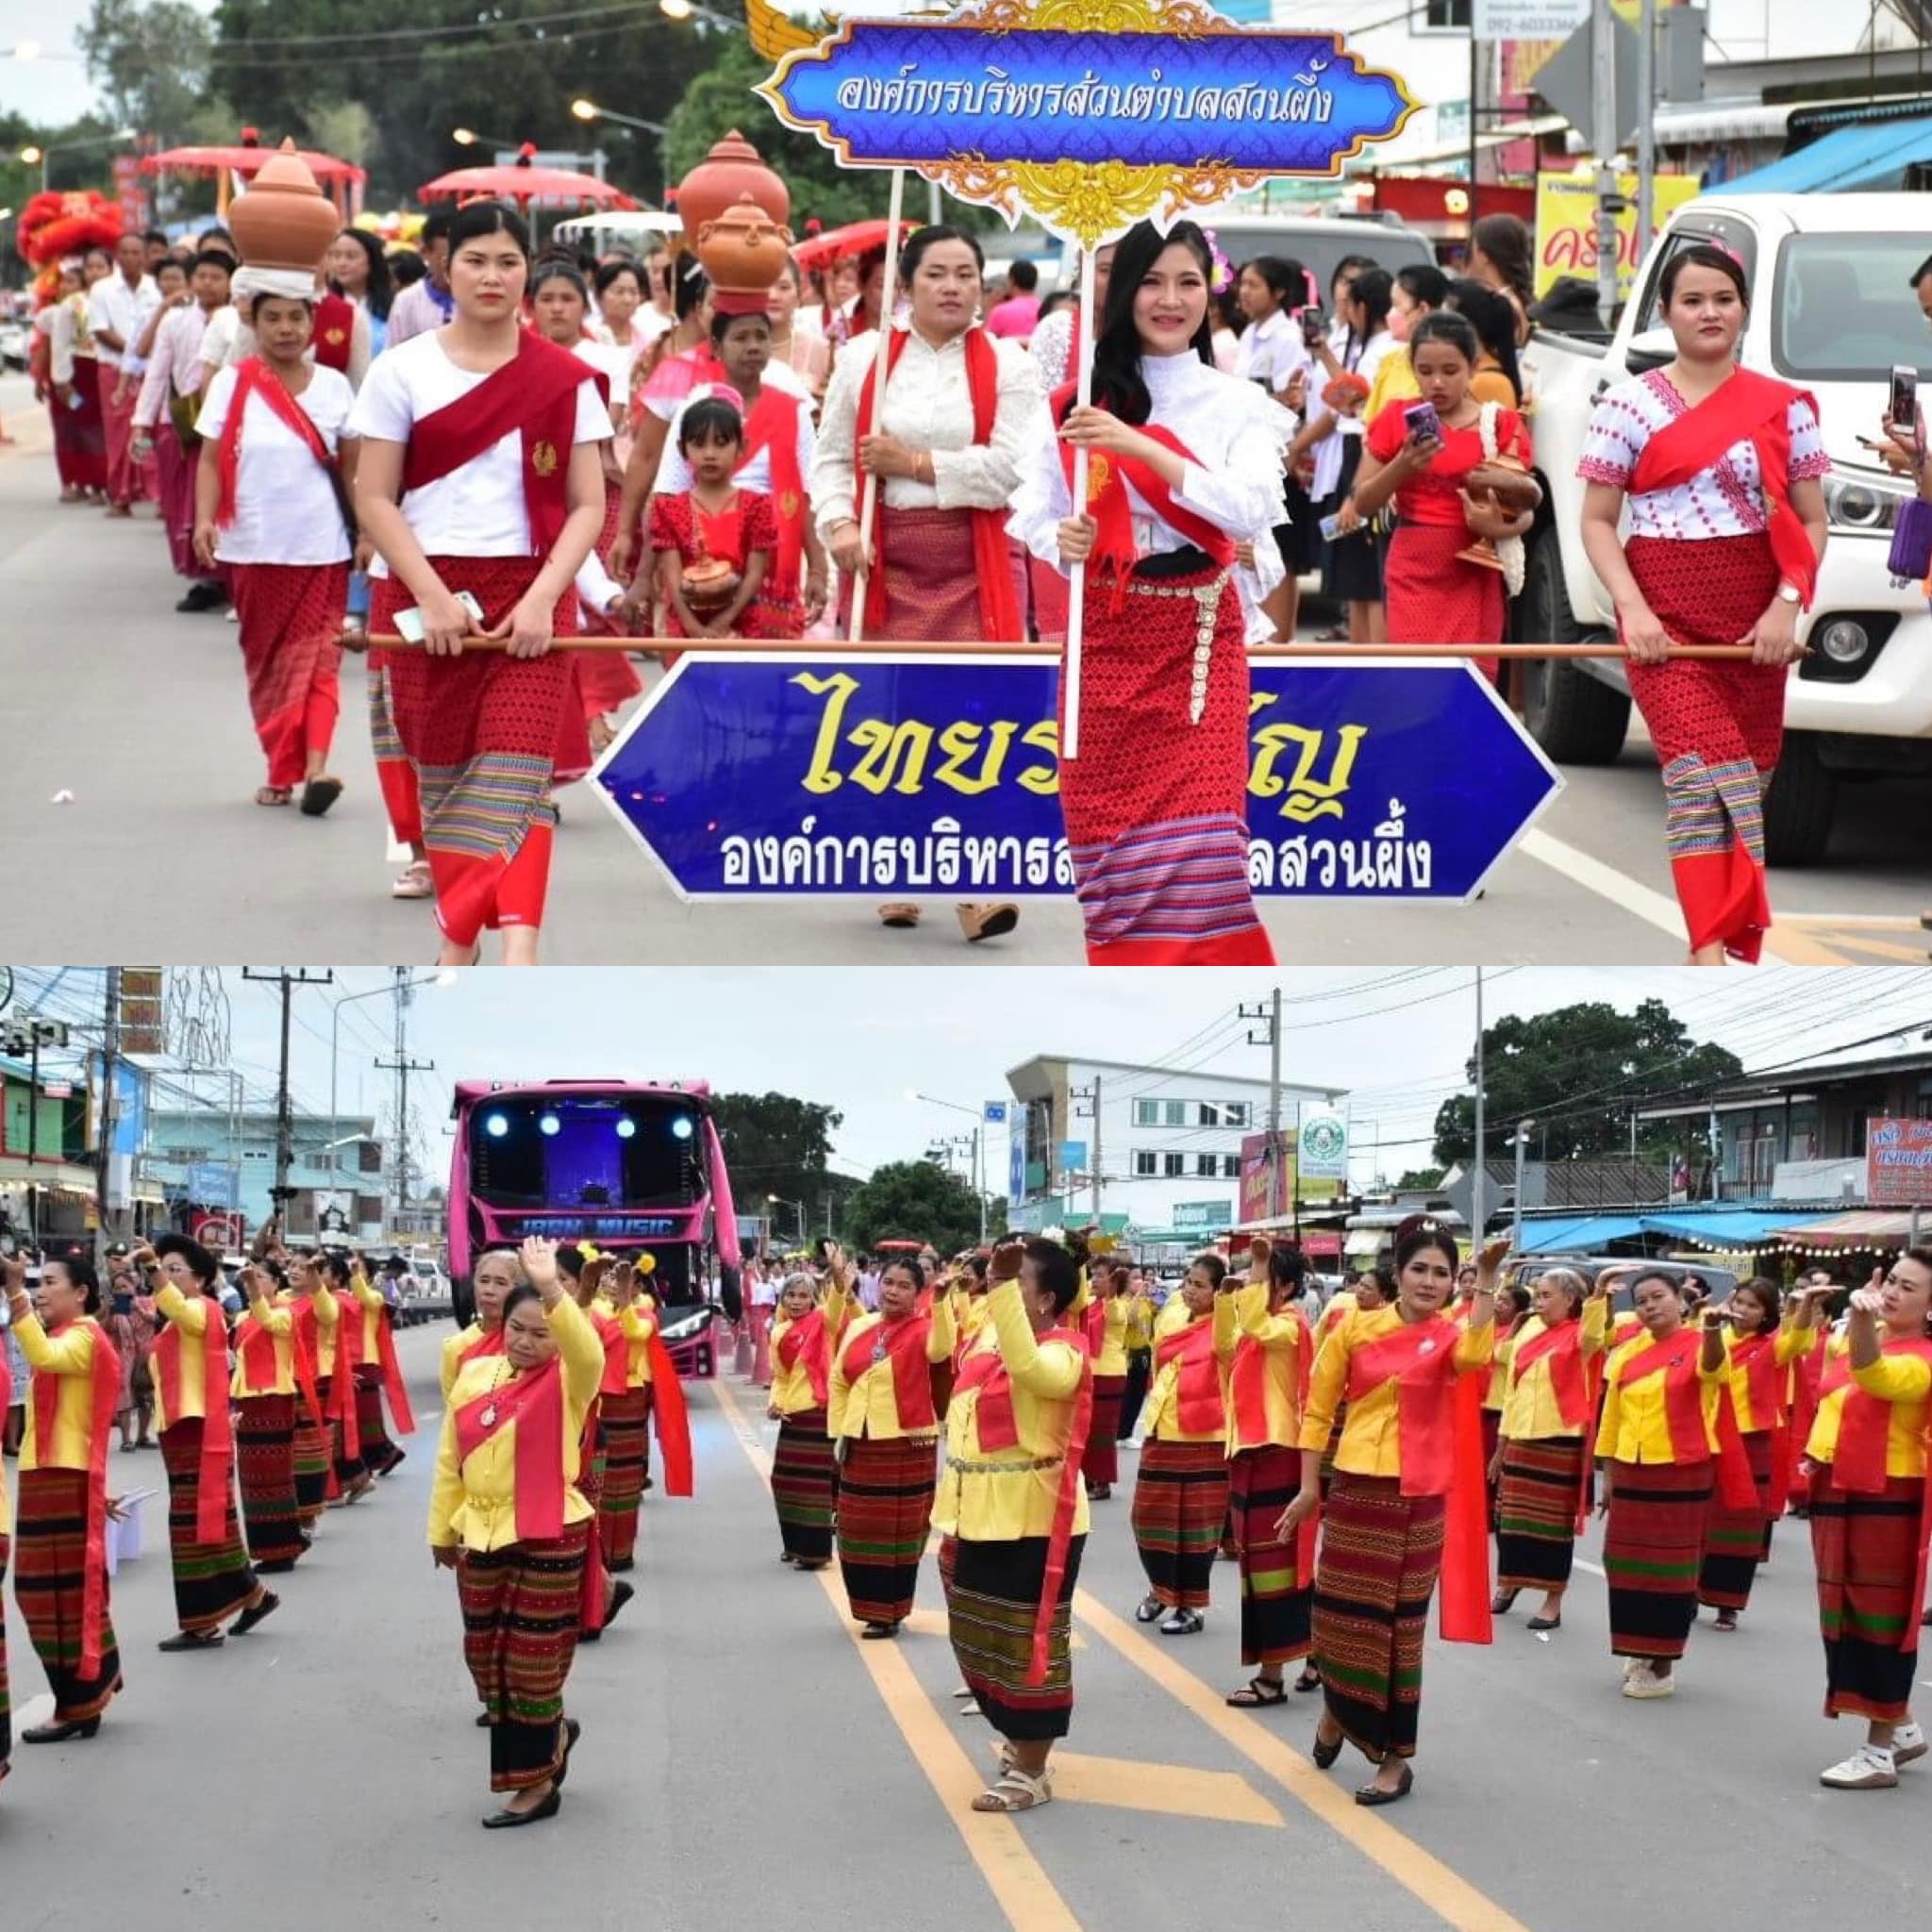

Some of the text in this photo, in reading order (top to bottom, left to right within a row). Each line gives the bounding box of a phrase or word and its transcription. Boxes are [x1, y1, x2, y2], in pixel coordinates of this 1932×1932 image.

[837, 58, 1333, 124] องค์การบริหารส่วนตำบลสวนผึ้ง
[596, 1219, 673, 1236] MUSIC
